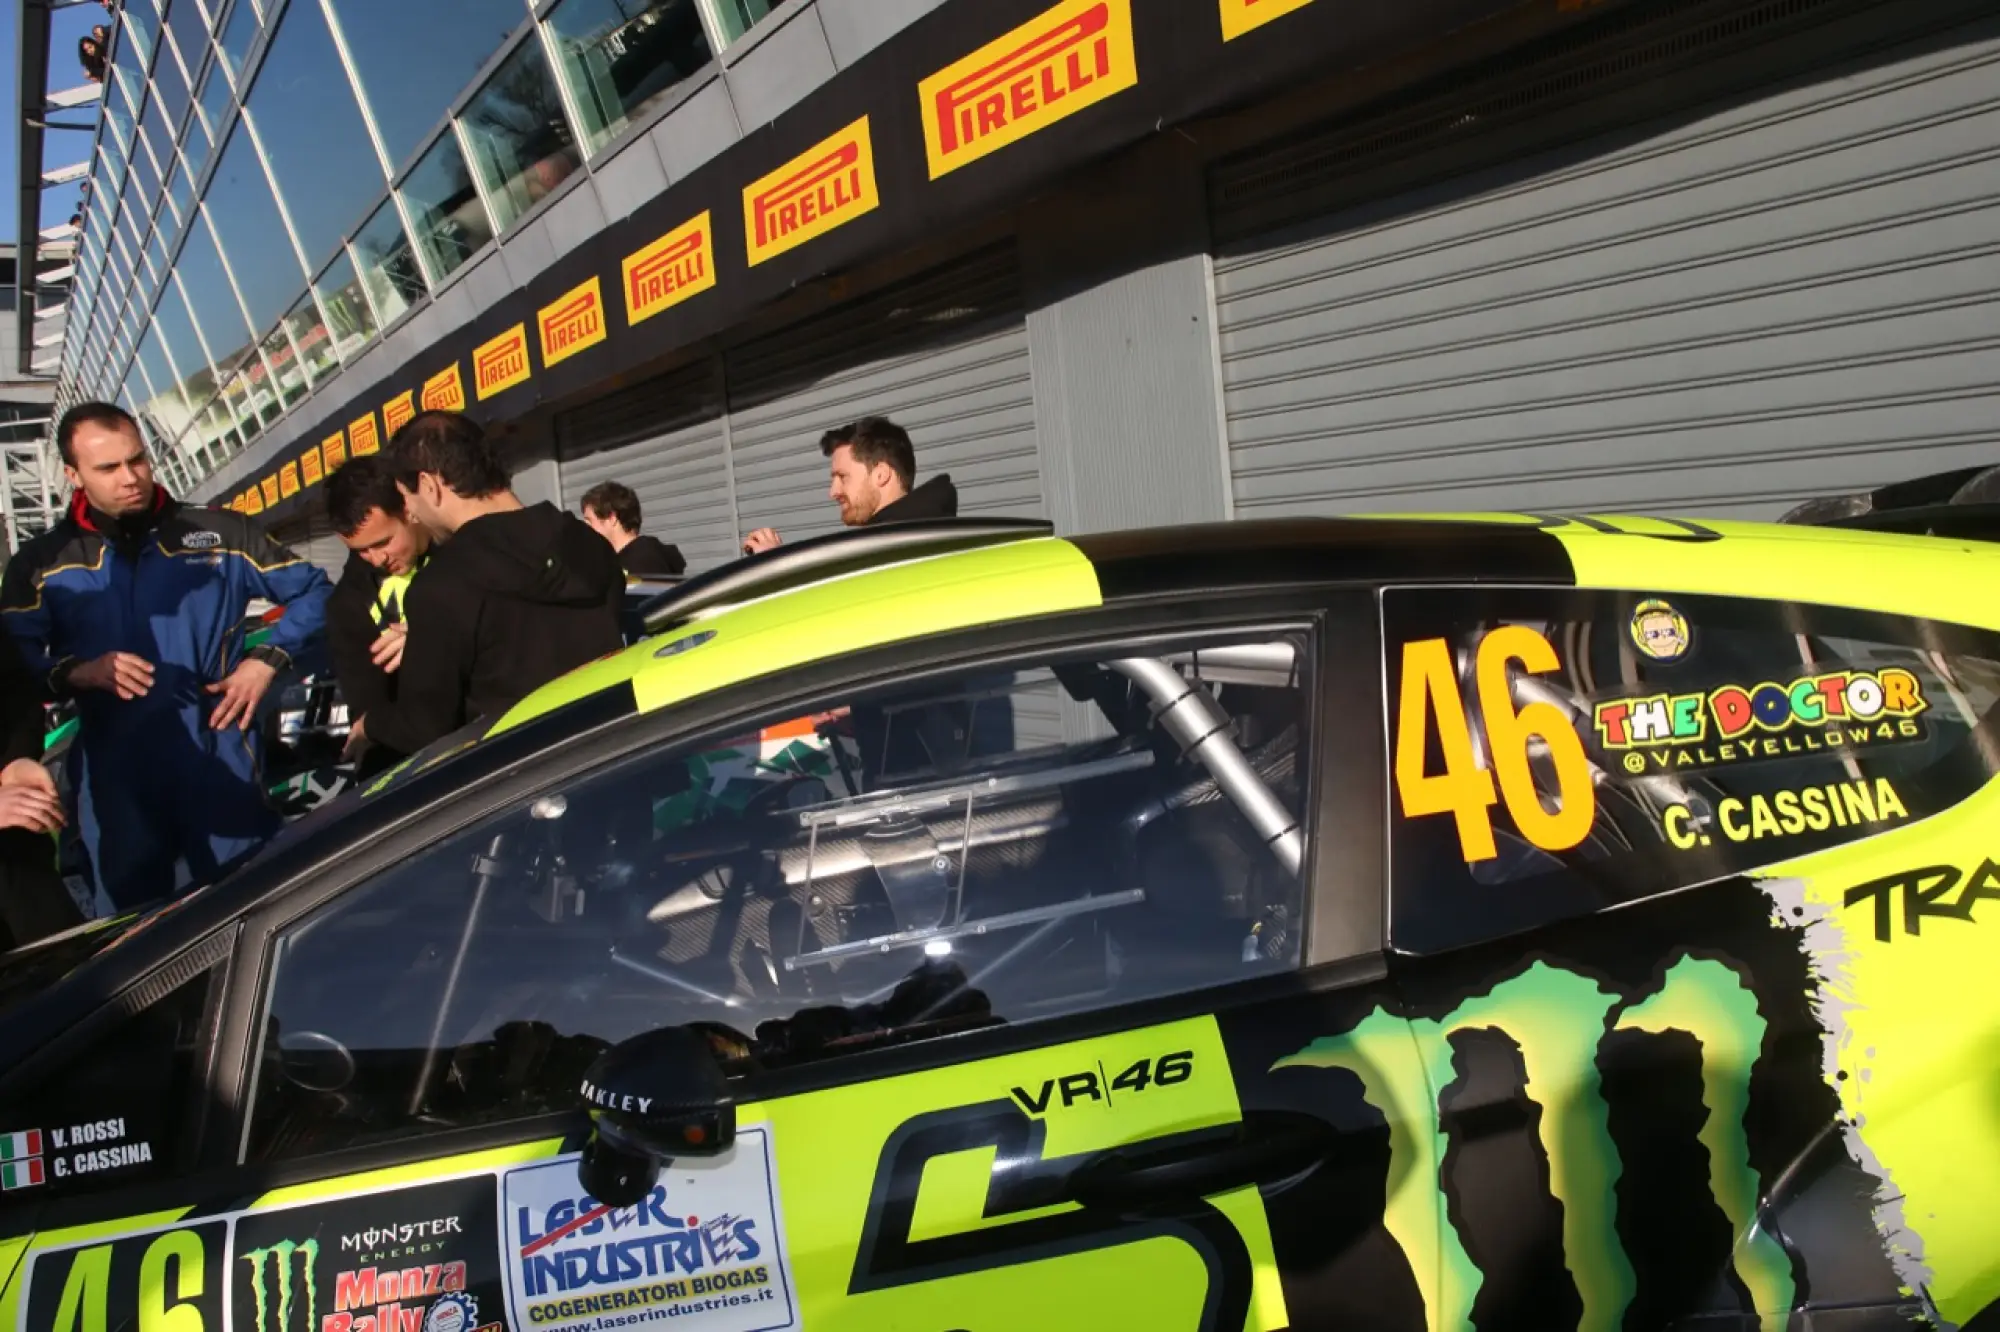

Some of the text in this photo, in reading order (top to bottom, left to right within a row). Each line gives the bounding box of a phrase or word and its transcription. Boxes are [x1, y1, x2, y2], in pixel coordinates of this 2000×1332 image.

[935, 3, 1110, 157] PIRELLI
[752, 140, 862, 249] PIRELLI
[629, 230, 705, 311] PIRELLI
[543, 291, 599, 356] PIRELLI
[477, 336, 524, 390] PIRELLI
[1594, 668, 1929, 749] THE DOCTOR
[1395, 624, 1596, 863] 46
[1623, 719, 1919, 774] @VALEYELLOW46
[1664, 776, 1910, 850] C. CASSINA
[51, 1117, 126, 1148] V. ROSSI
[54, 1141, 153, 1177] C. CASSINA
[341, 1215, 463, 1252] MONSTER
[360, 1240, 445, 1263] ENERGY
[521, 1213, 762, 1297] INDUSTRIES
[334, 1259, 468, 1313] Monza
[528, 1266, 769, 1324] COGENERATORI BIOGAS
[543, 1287, 775, 1332] ww.laserindustries.it
